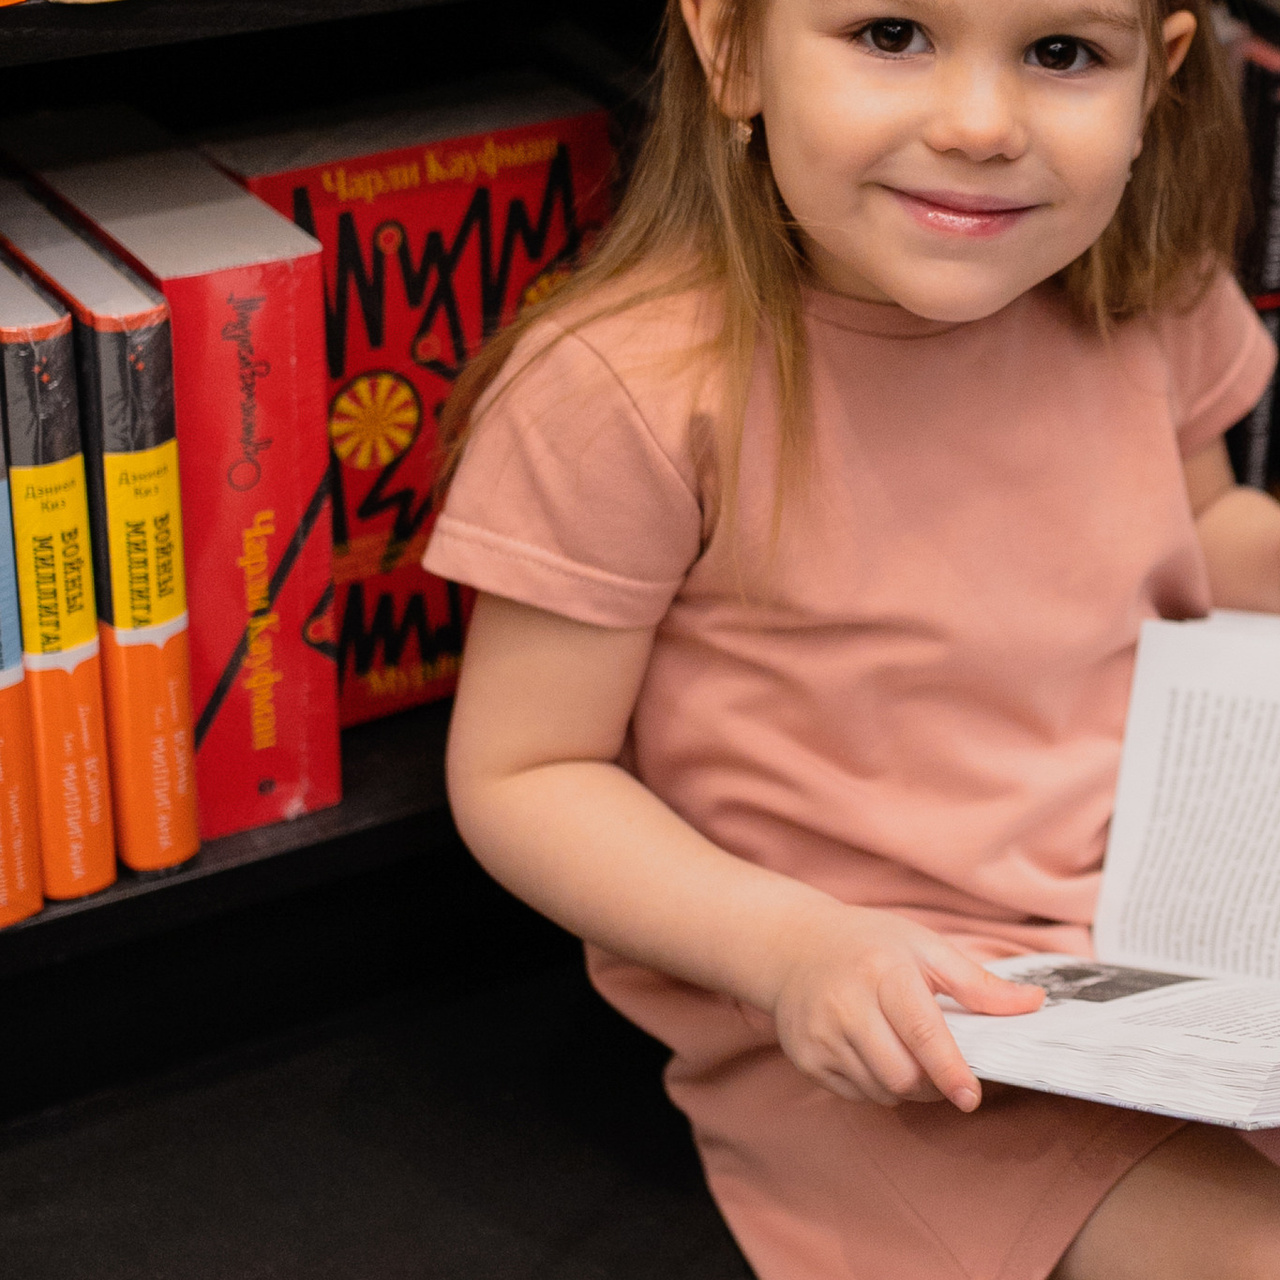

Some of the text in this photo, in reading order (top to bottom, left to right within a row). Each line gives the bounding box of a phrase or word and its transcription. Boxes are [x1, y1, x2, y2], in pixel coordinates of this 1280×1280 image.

[322, 166, 421, 204] Чарли
[60, 527, 84, 616] ВОЙНЫ
[153, 512, 175, 599] ВОЙНЫ
